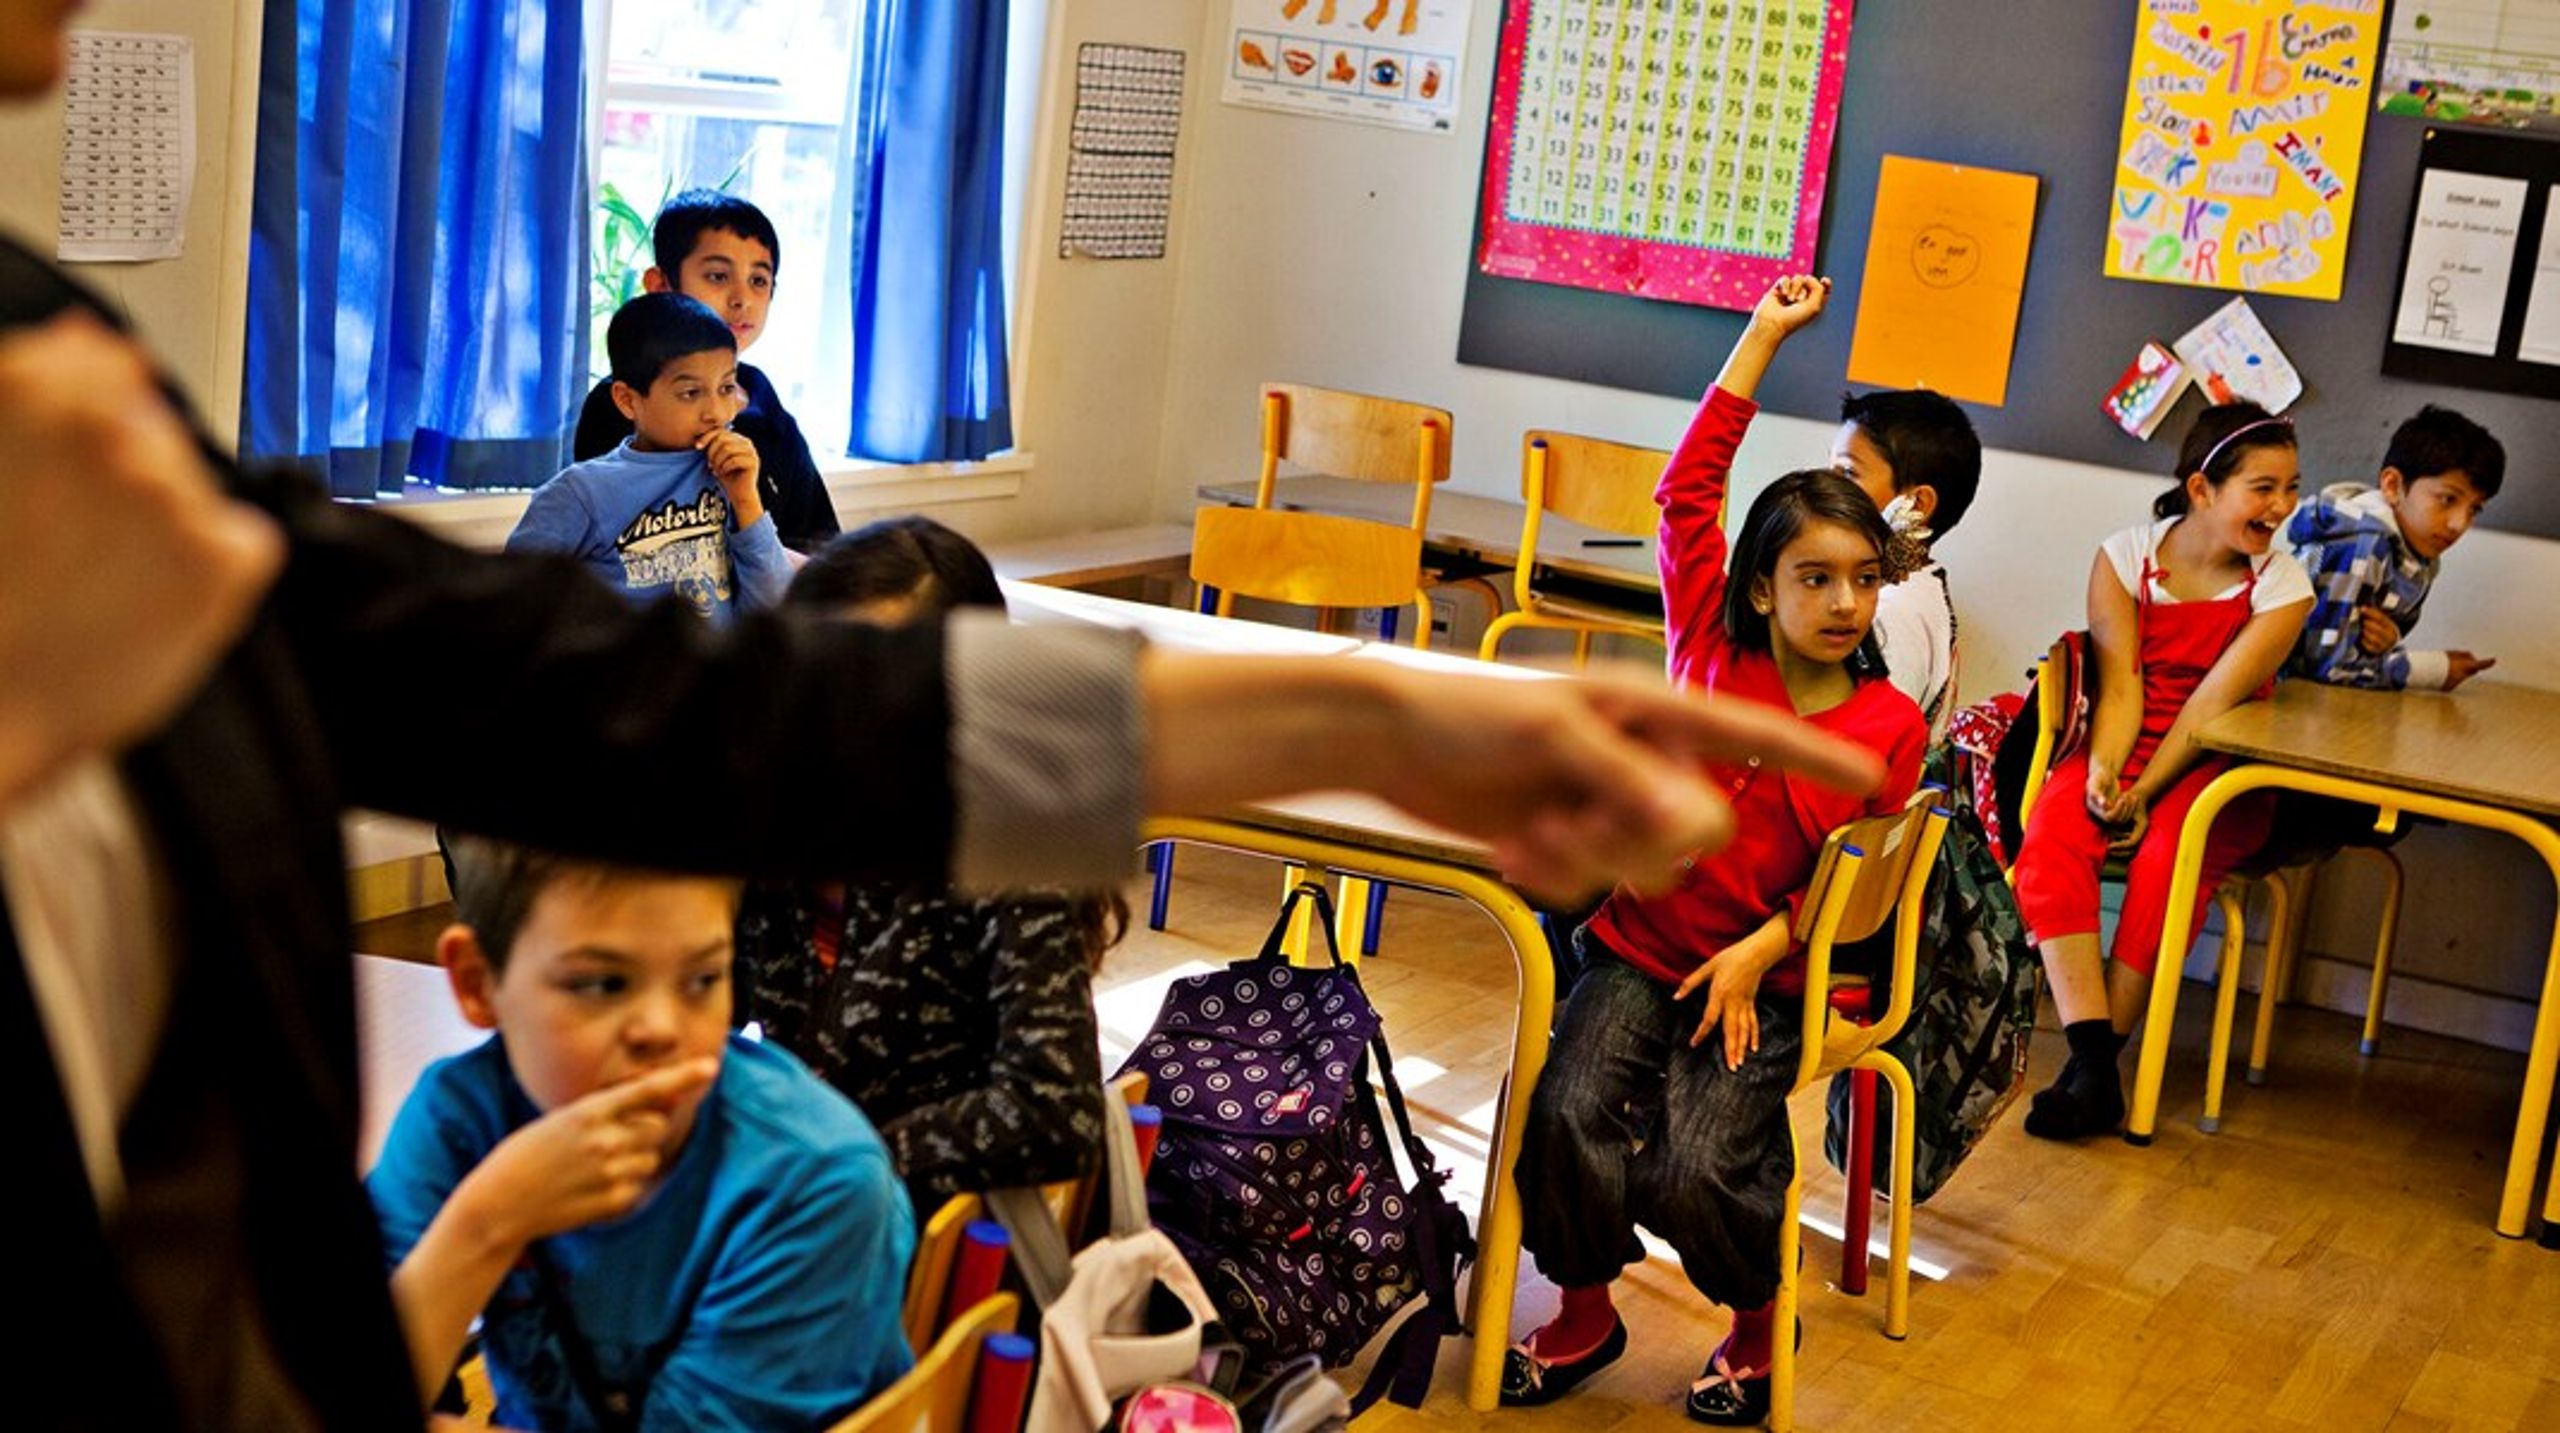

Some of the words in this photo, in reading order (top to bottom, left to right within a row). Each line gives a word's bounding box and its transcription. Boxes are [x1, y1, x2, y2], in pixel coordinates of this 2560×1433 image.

[1543, 15, 1551, 30] 7
[1567, 18, 1584, 34] 17
[1594, 21, 1611, 37] 27
[1622, 24, 1639, 40] 37
[1650, 28, 1668, 44] 47
[1678, 31, 1695, 47] 57
[1707, 34, 1724, 50] 67
[1736, 37, 1753, 54] 77
[1764, 41, 1782, 57] 87
[1794, 44, 1811, 61] 97
[1711, 3, 1729, 19] 68
[1740, 6, 1758, 22] 78
[1769, 9, 1787, 26] 88
[1799, 12, 1816, 29] 98
[1539, 46, 1547, 61] 6
[1563, 49, 1579, 64] 16
[1590, 52, 1606, 68] 26
[1618, 55, 1634, 71] 36
[1646, 59, 1664, 75] 46
[1674, 62, 1691, 78] 56
[1702, 65, 1720, 82] 66
[1731, 69, 1748, 85] 76
[1760, 72, 1777, 89] 86
[1789, 76, 1806, 92] 96
[1535, 76, 1543, 91] 5
[1559, 79, 1575, 95] 15
[1586, 83, 1602, 98] 25
[1614, 86, 1630, 102] 35
[1641, 89, 1659, 106] 45
[1670, 93, 1687, 109] 55
[1698, 96, 1715, 113] 65
[1726, 100, 1744, 116] 75
[1755, 103, 1773, 120] 85
[1784, 107, 1802, 124] 95
[1531, 106, 1539, 122] 4
[1555, 110, 1571, 125] 14
[1582, 113, 1598, 129] 24
[1609, 117, 1626, 133] 34
[1637, 120, 1655, 136] 44
[1665, 124, 1682, 140] 54
[1693, 127, 1711, 144] 64
[1722, 131, 1739, 147] 74
[1750, 134, 1768, 151] 84
[1779, 138, 1797, 155] 94
[1551, 140, 1567, 155] 13
[1578, 143, 1594, 159] 23
[1605, 147, 1622, 163] 33
[1633, 150, 1651, 167] 43
[1661, 154, 1678, 170] 53
[1689, 158, 1706, 174] 63
[1717, 161, 1734, 178] 73
[1746, 165, 1763, 182] 83
[1774, 169, 1792, 186] 93
[1524, 166, 1531, 182] 2
[1547, 170, 1563, 185] 12
[1574, 173, 1590, 189] 22
[1601, 177, 1618, 193] 32
[1629, 181, 1647, 197] 42
[1656, 184, 1673, 201] 52
[1684, 188, 1702, 205] 62
[1713, 192, 1730, 208] 72
[1741, 196, 1758, 212] 82
[1769, 200, 1787, 216] 92
[1544, 199, 1558, 215] 11
[1570, 203, 1585, 219] 21
[1625, 211, 1641, 227] 41
[1652, 215, 1668, 231] 51
[1680, 218, 1696, 235] 61
[1708, 222, 1724, 239] 71
[1737, 226, 1753, 243] 81
[1765, 230, 1781, 247] 91
